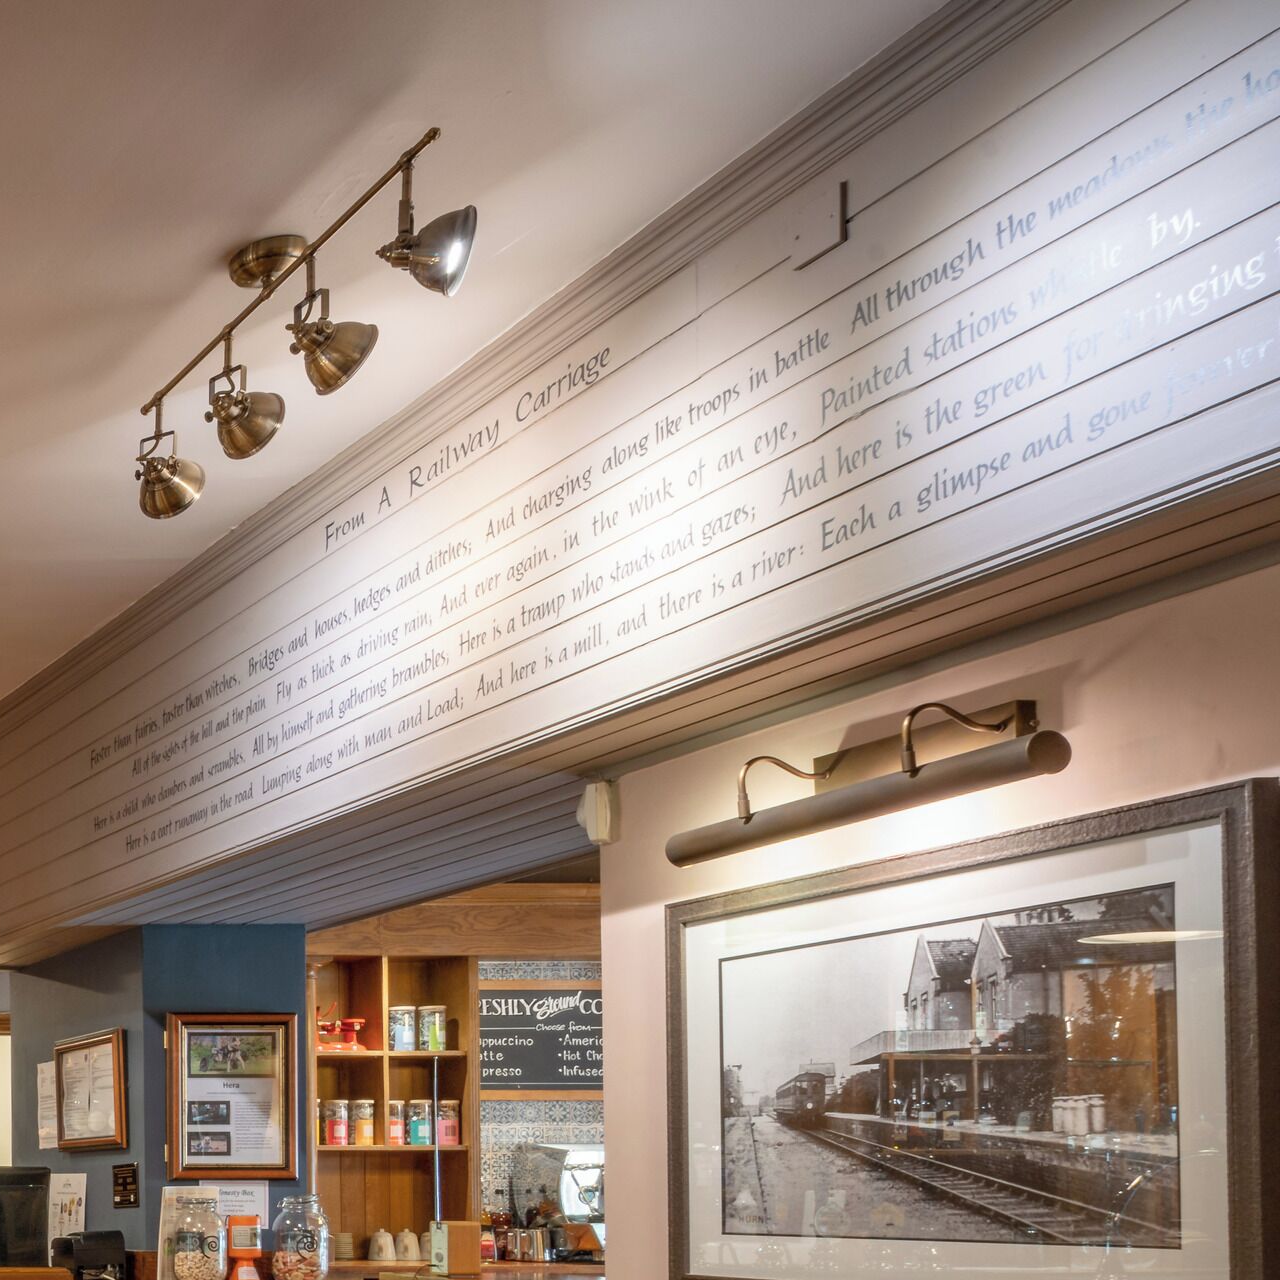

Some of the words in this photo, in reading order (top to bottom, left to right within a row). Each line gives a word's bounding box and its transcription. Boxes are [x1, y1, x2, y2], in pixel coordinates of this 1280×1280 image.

[820, 346, 913, 428] Painted
[923, 301, 1019, 368] stations
[1147, 207, 1201, 249] by.
[850, 293, 880, 335] All
[886, 237, 986, 313] through
[995, 210, 1037, 251] the
[325, 512, 365, 552] From
[378, 486, 391, 513] A
[409, 419, 499, 497] Railway
[516, 347, 610, 422] Carriage
[485, 512, 515, 543] And
[523, 465, 592, 520] charging
[602, 435, 649, 474] along
[655, 413, 682, 446] like
[689, 384, 740, 427] troops
[749, 368, 767, 393] in
[775, 328, 830, 378] battle
[781, 457, 828, 504] And
[837, 439, 882, 478] here
[895, 420, 913, 449] is
[924, 397, 962, 435] the
[973, 361, 1047, 419] green
[820, 506, 876, 551] Each
[887, 500, 903, 522] a
[916, 451, 1012, 514] glimpse
[1022, 412, 1074, 463] and
[1089, 390, 1152, 440] gone
[440, 585, 468, 616] And
[475, 574, 500, 598] ever
[563, 528, 580, 553] in
[592, 508, 619, 537] the
[629, 477, 674, 517] wink
[687, 457, 706, 488] of
[717, 443, 744, 473] an
[754, 419, 797, 455] eye,
[459, 630, 486, 656] Here
[492, 617, 502, 638] is
[507, 618, 516, 633] a
[520, 593, 566, 628] tramp
[571, 572, 604, 603] who
[609, 546, 656, 583] stands
[661, 523, 695, 561] and
[701, 504, 757, 546] gazes;
[475, 667, 503, 699] And
[510, 655, 537, 686] here
[544, 647, 554, 670] is
[558, 647, 568, 663] a
[574, 626, 609, 656] mill,
[617, 604, 648, 636] and
[658, 587, 702, 620] there
[712, 572, 725, 598] is
[732, 570, 743, 588] a
[533, 991, 582, 1020] ground
[536, 1023, 565, 1032] Choose
[568, 1021, 591, 1033] from
[563, 1050, 581, 1061] Hot
[223, 1081, 240, 1089] Hera
[738, 1214, 765, 1224] HURN
